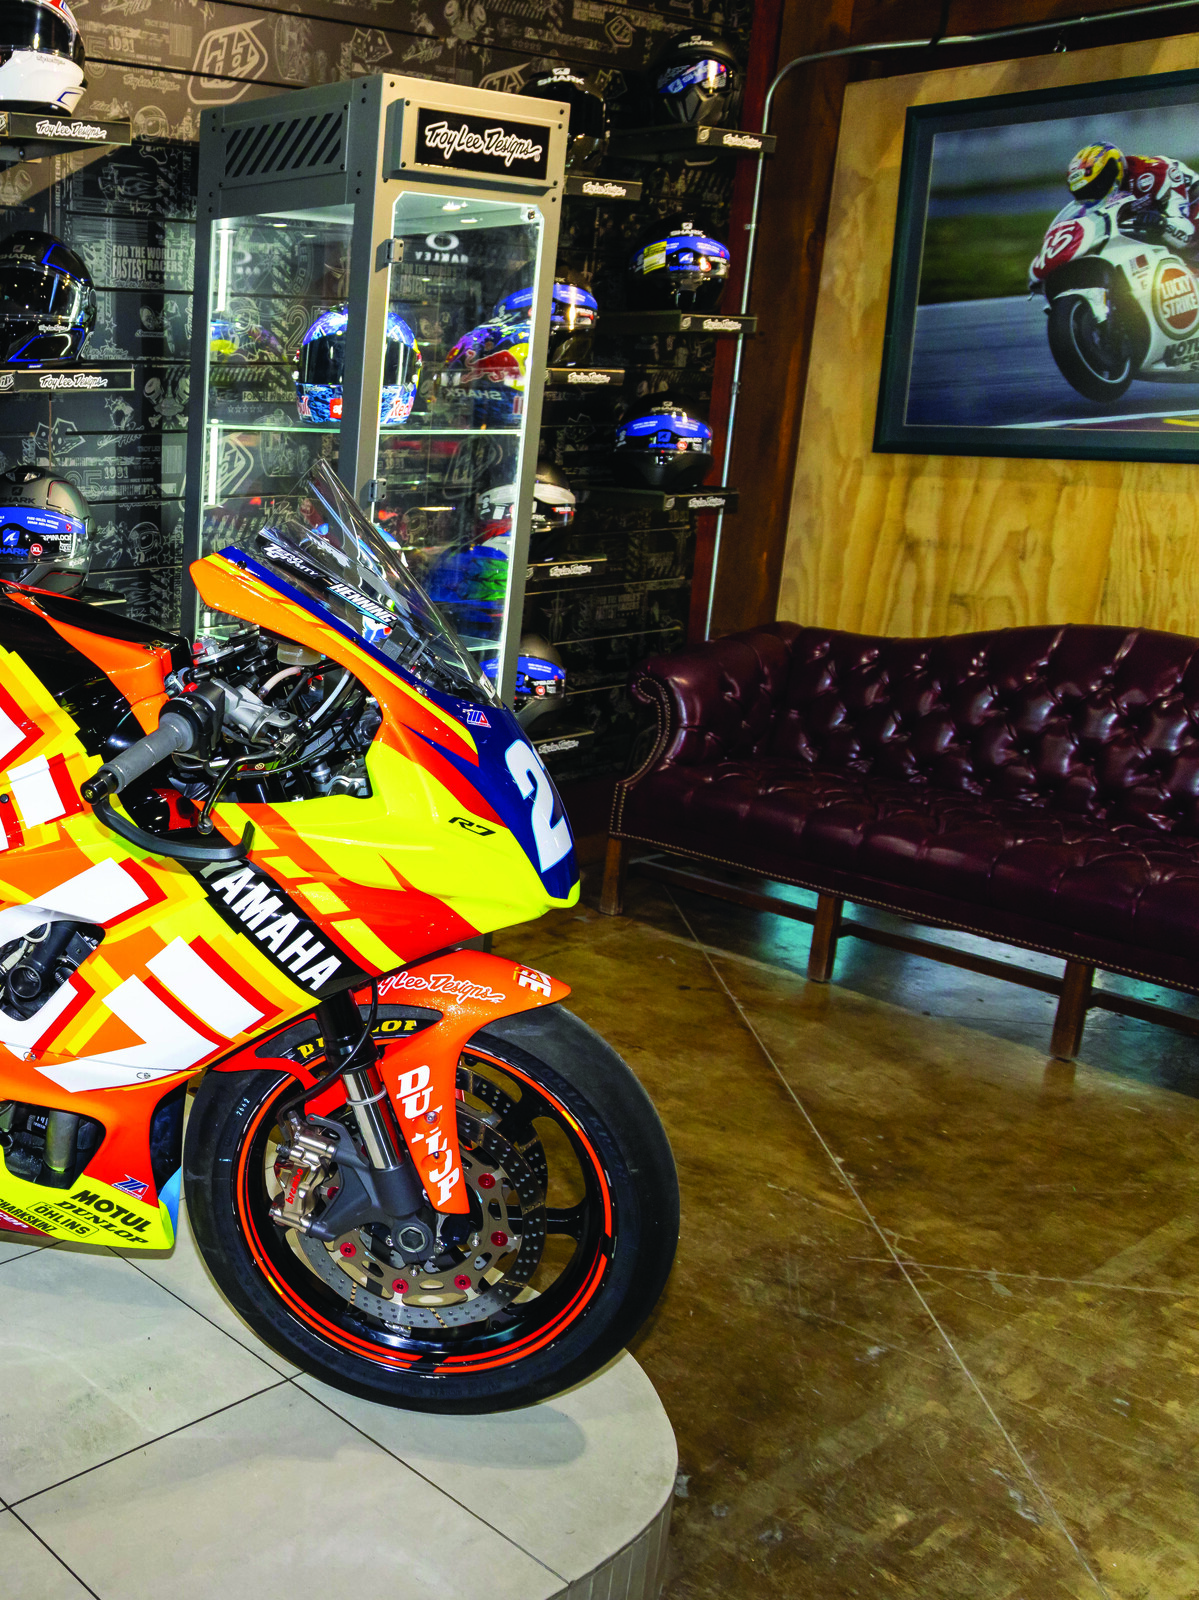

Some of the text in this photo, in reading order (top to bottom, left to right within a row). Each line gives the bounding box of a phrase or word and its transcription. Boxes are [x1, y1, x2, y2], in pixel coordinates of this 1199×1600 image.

[537, 74, 585, 86] SHARK
[55, 122, 71, 136] Lee
[71, 121, 107, 140] Designs
[424, 121, 542, 167] Troy Lee Designs
[112, 245, 184, 260] FOR THE WORLD'S
[112, 258, 184, 279] FASTEST RACERS
[1161, 275, 1191, 299] LUCKY
[1162, 294, 1198, 320] STRIKE
[39, 374, 108, 390] Troy Lee Designs
[329, 583, 399, 623] HENNING
[199, 858, 343, 992] YAMAHA
[393, 971, 428, 990] Lee
[426, 974, 506, 1004] Designs
[285, 1167, 303, 1205] brembo
[33, 1203, 91, 1235] ÖHLINS
[54, 1200, 149, 1244] DUNLOP
[69, 1189, 152, 1233] MOTUL
